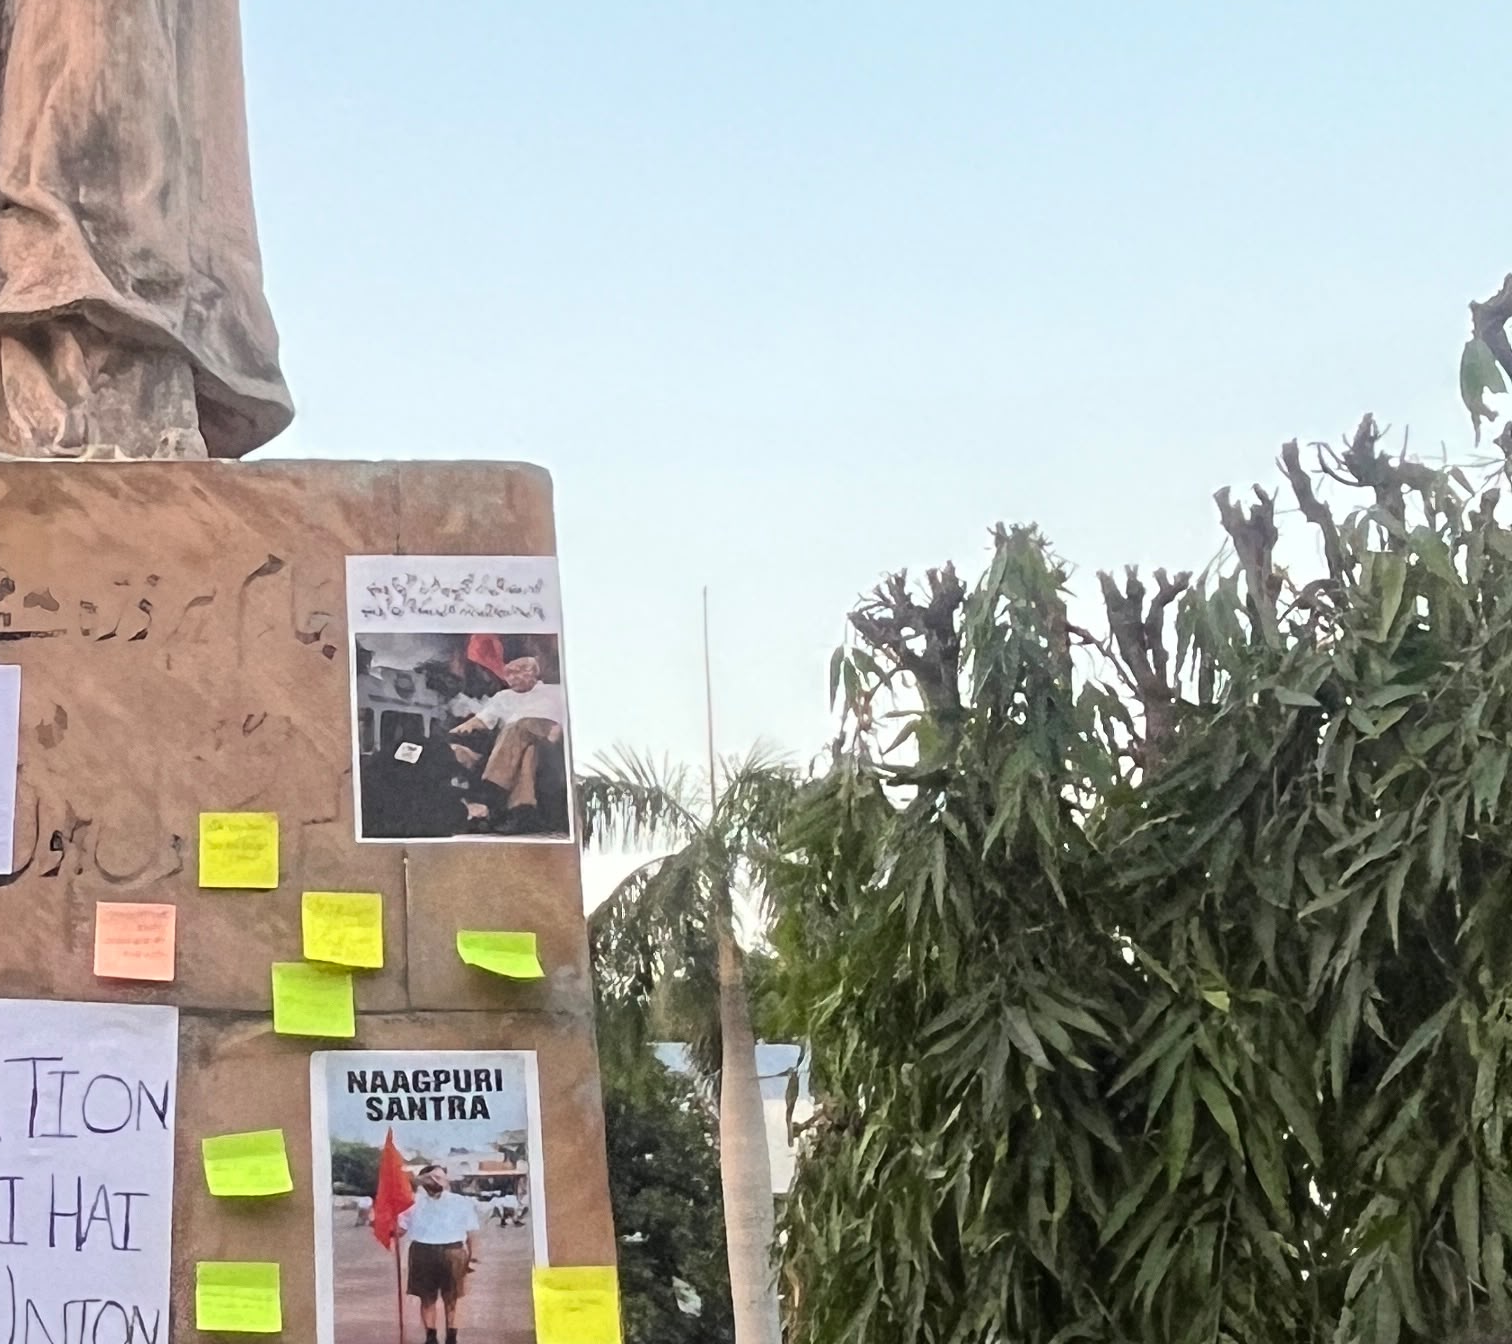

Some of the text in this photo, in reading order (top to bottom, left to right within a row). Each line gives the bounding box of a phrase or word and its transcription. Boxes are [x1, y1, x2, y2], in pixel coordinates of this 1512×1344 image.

[347, 1069, 504, 1094] NAAGPURI
[366, 1095, 491, 1122] SANTRA
[49, 1174, 150, 1253] HAI
